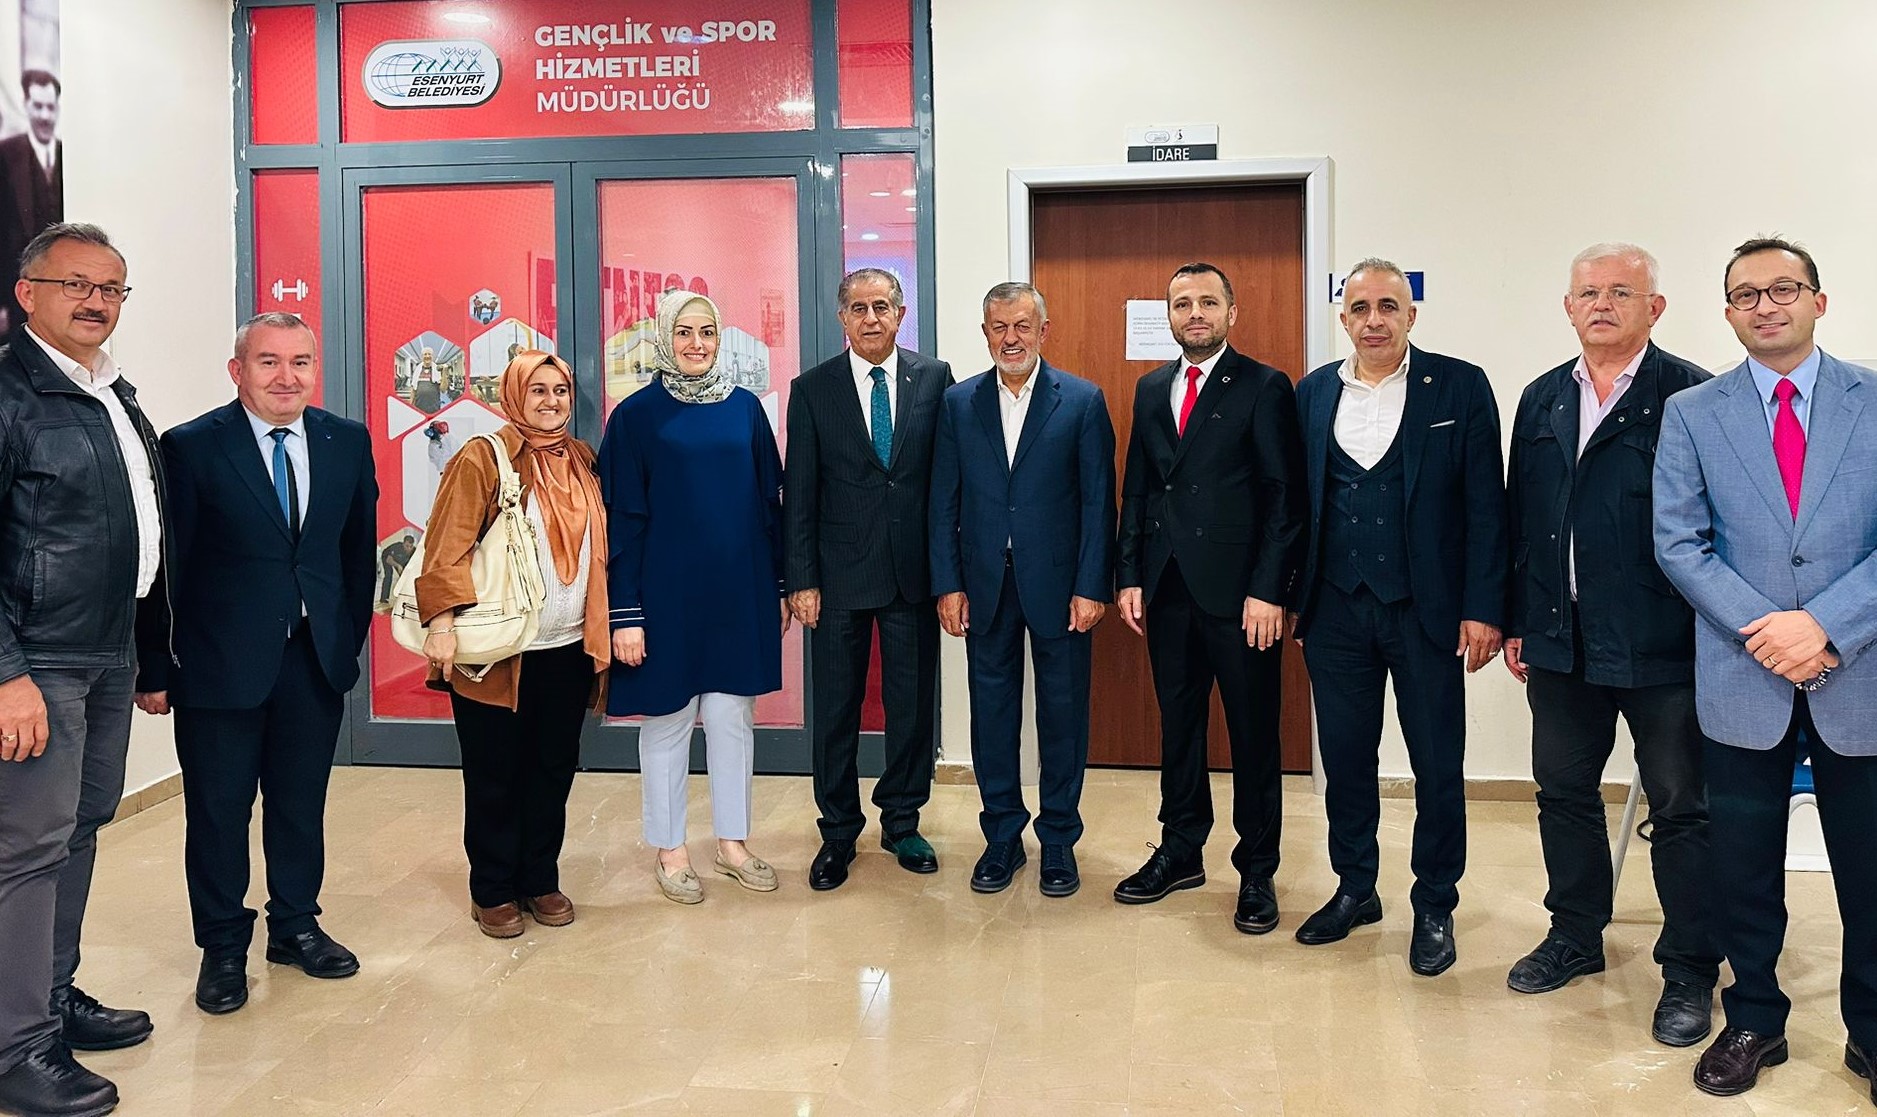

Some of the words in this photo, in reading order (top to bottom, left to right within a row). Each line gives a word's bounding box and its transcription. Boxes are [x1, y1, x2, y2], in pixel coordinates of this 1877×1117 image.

[535, 17, 653, 51] GENÇLİK
[660, 26, 693, 44] ve
[701, 20, 777, 43] SPOR
[535, 48, 700, 80] HİZMETLERİ
[407, 83, 486, 98] BELEDİYESİ
[412, 74, 485, 86] ESENYURT
[536, 82, 711, 113] MÜDÜRLÜĞÜ
[1152, 145, 1190, 161] İDARE
